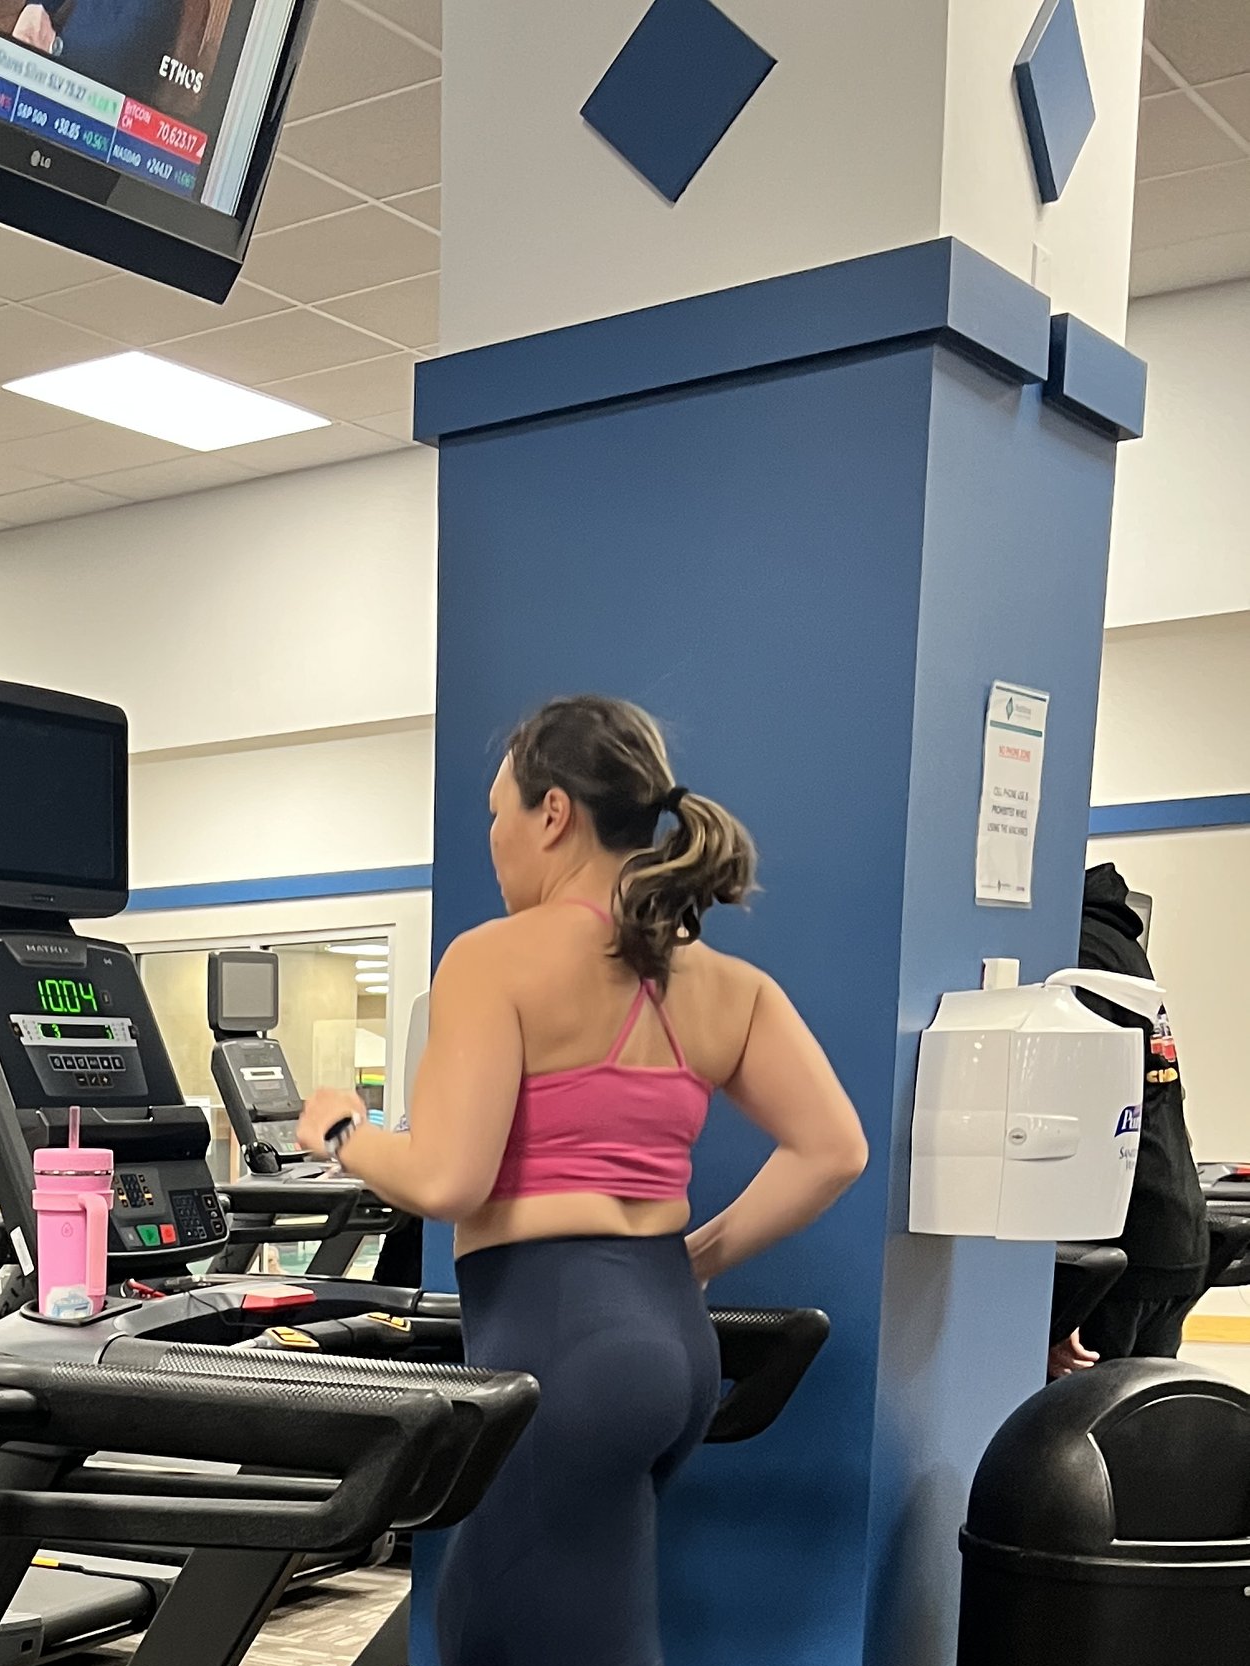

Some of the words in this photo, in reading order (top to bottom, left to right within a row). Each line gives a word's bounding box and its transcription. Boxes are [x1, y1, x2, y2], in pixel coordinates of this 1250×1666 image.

[158, 55, 204, 93] ETHOS
[112, 144, 141, 167] NASDAQ
[25, 944, 70, 954] MATRIX
